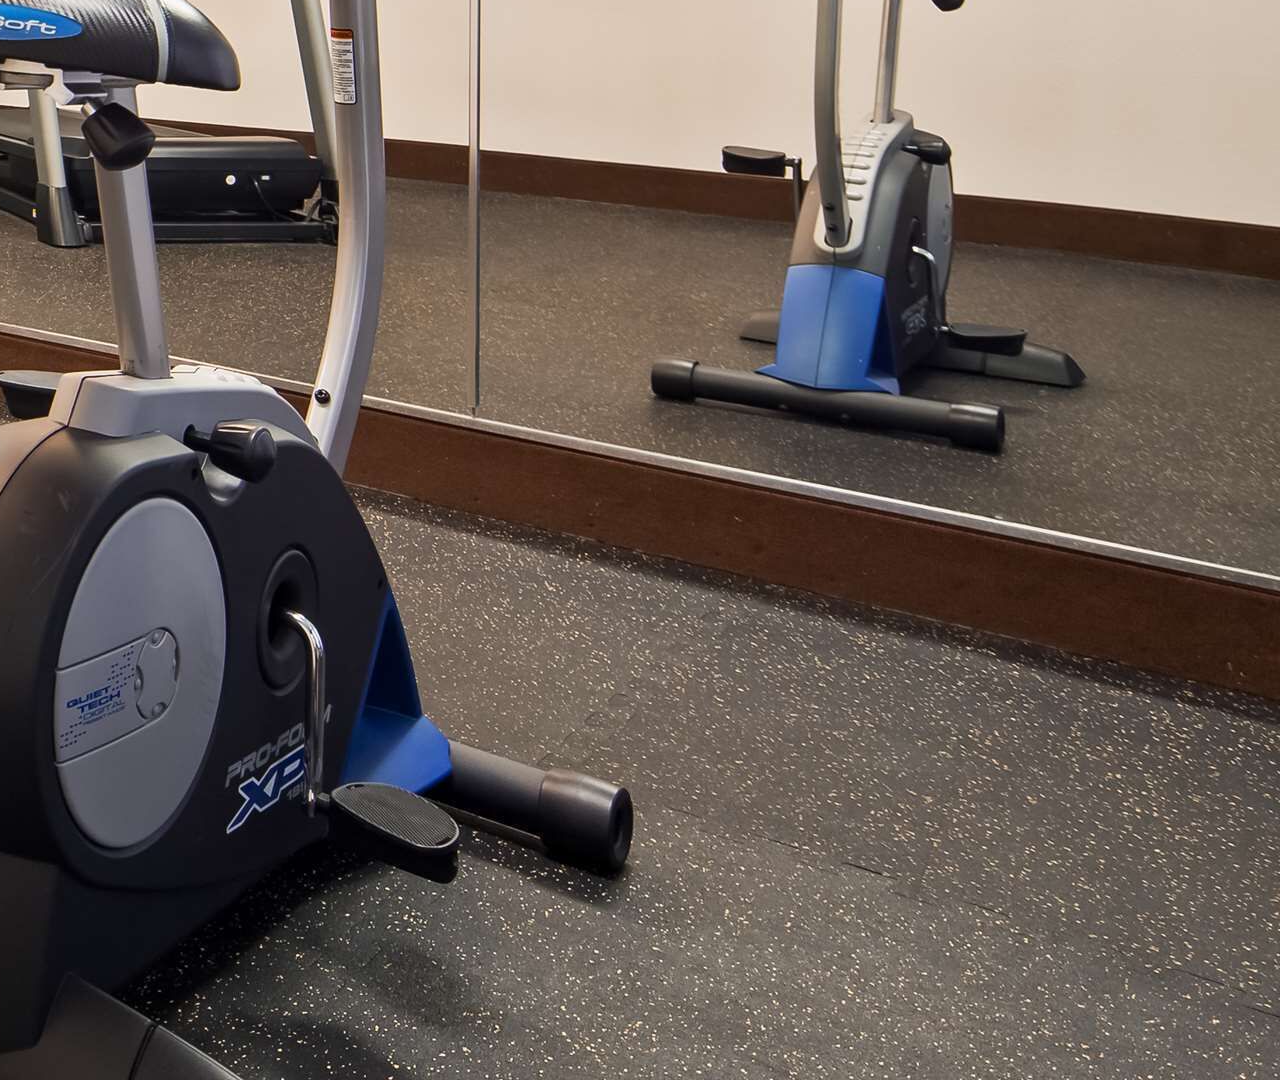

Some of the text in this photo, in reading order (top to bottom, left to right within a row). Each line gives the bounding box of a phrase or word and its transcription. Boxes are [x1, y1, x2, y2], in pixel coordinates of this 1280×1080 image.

[66, 685, 111, 708] QUIET
[78, 690, 121, 713] TECH
[226, 744, 305, 834] XP
